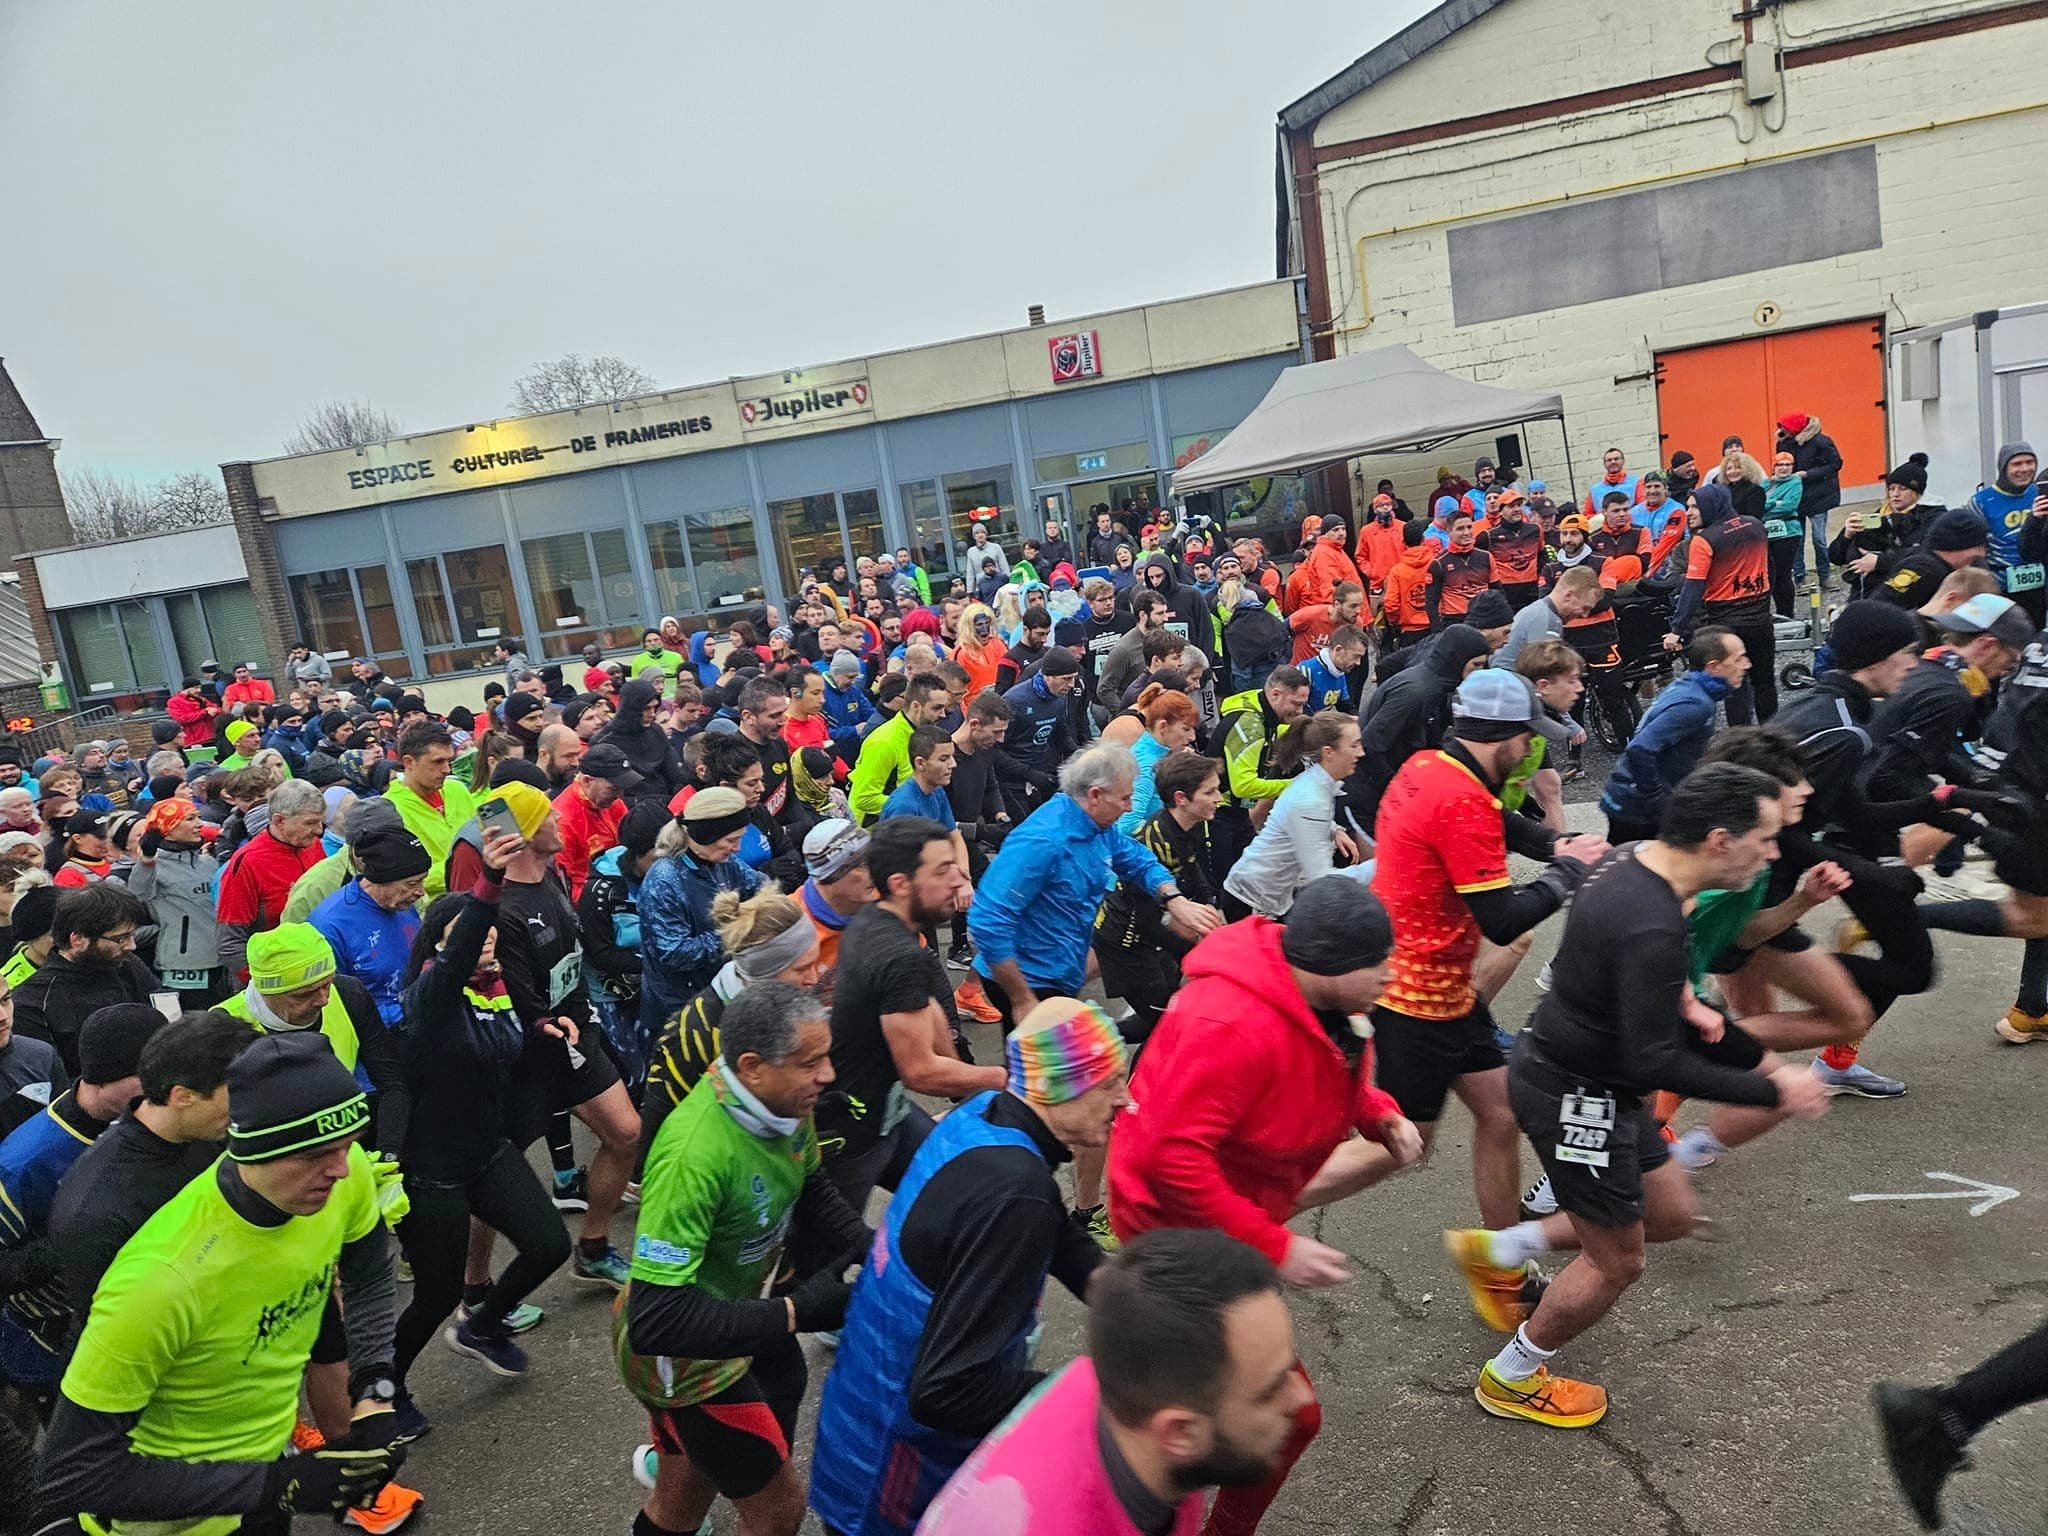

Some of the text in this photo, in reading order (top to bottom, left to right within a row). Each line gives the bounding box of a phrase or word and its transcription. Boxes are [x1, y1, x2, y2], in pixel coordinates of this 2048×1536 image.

[1081, 335, 1093, 371] Jupiler
[761, 388, 850, 420] Jupiler
[349, 415, 713, 490] ESPACE CULTUREL DE FRAMERIES
[2015, 571, 2043, 585] 1809
[1563, 1125, 1607, 1149] 7269
